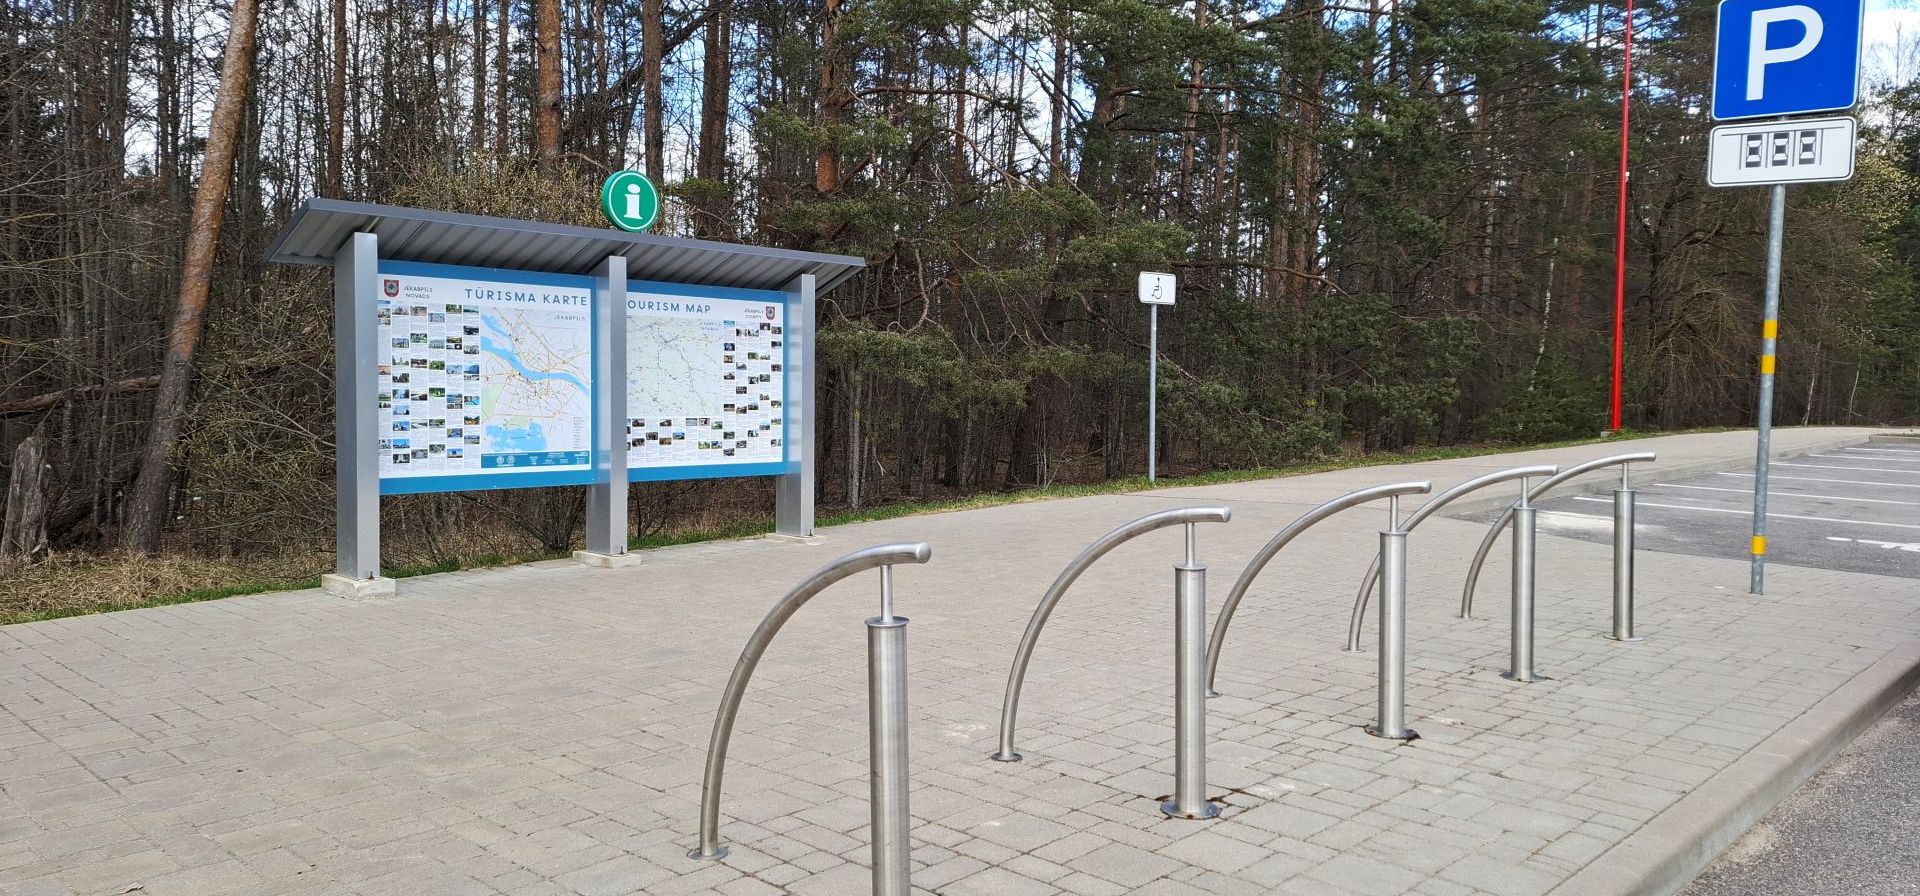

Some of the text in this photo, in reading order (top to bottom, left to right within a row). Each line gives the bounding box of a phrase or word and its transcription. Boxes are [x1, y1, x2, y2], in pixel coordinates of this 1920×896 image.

[1746, 5, 1824, 101] P
[464, 286, 588, 306] TŪRISMA KARTE
[627, 300, 711, 314] OURISM MAP
